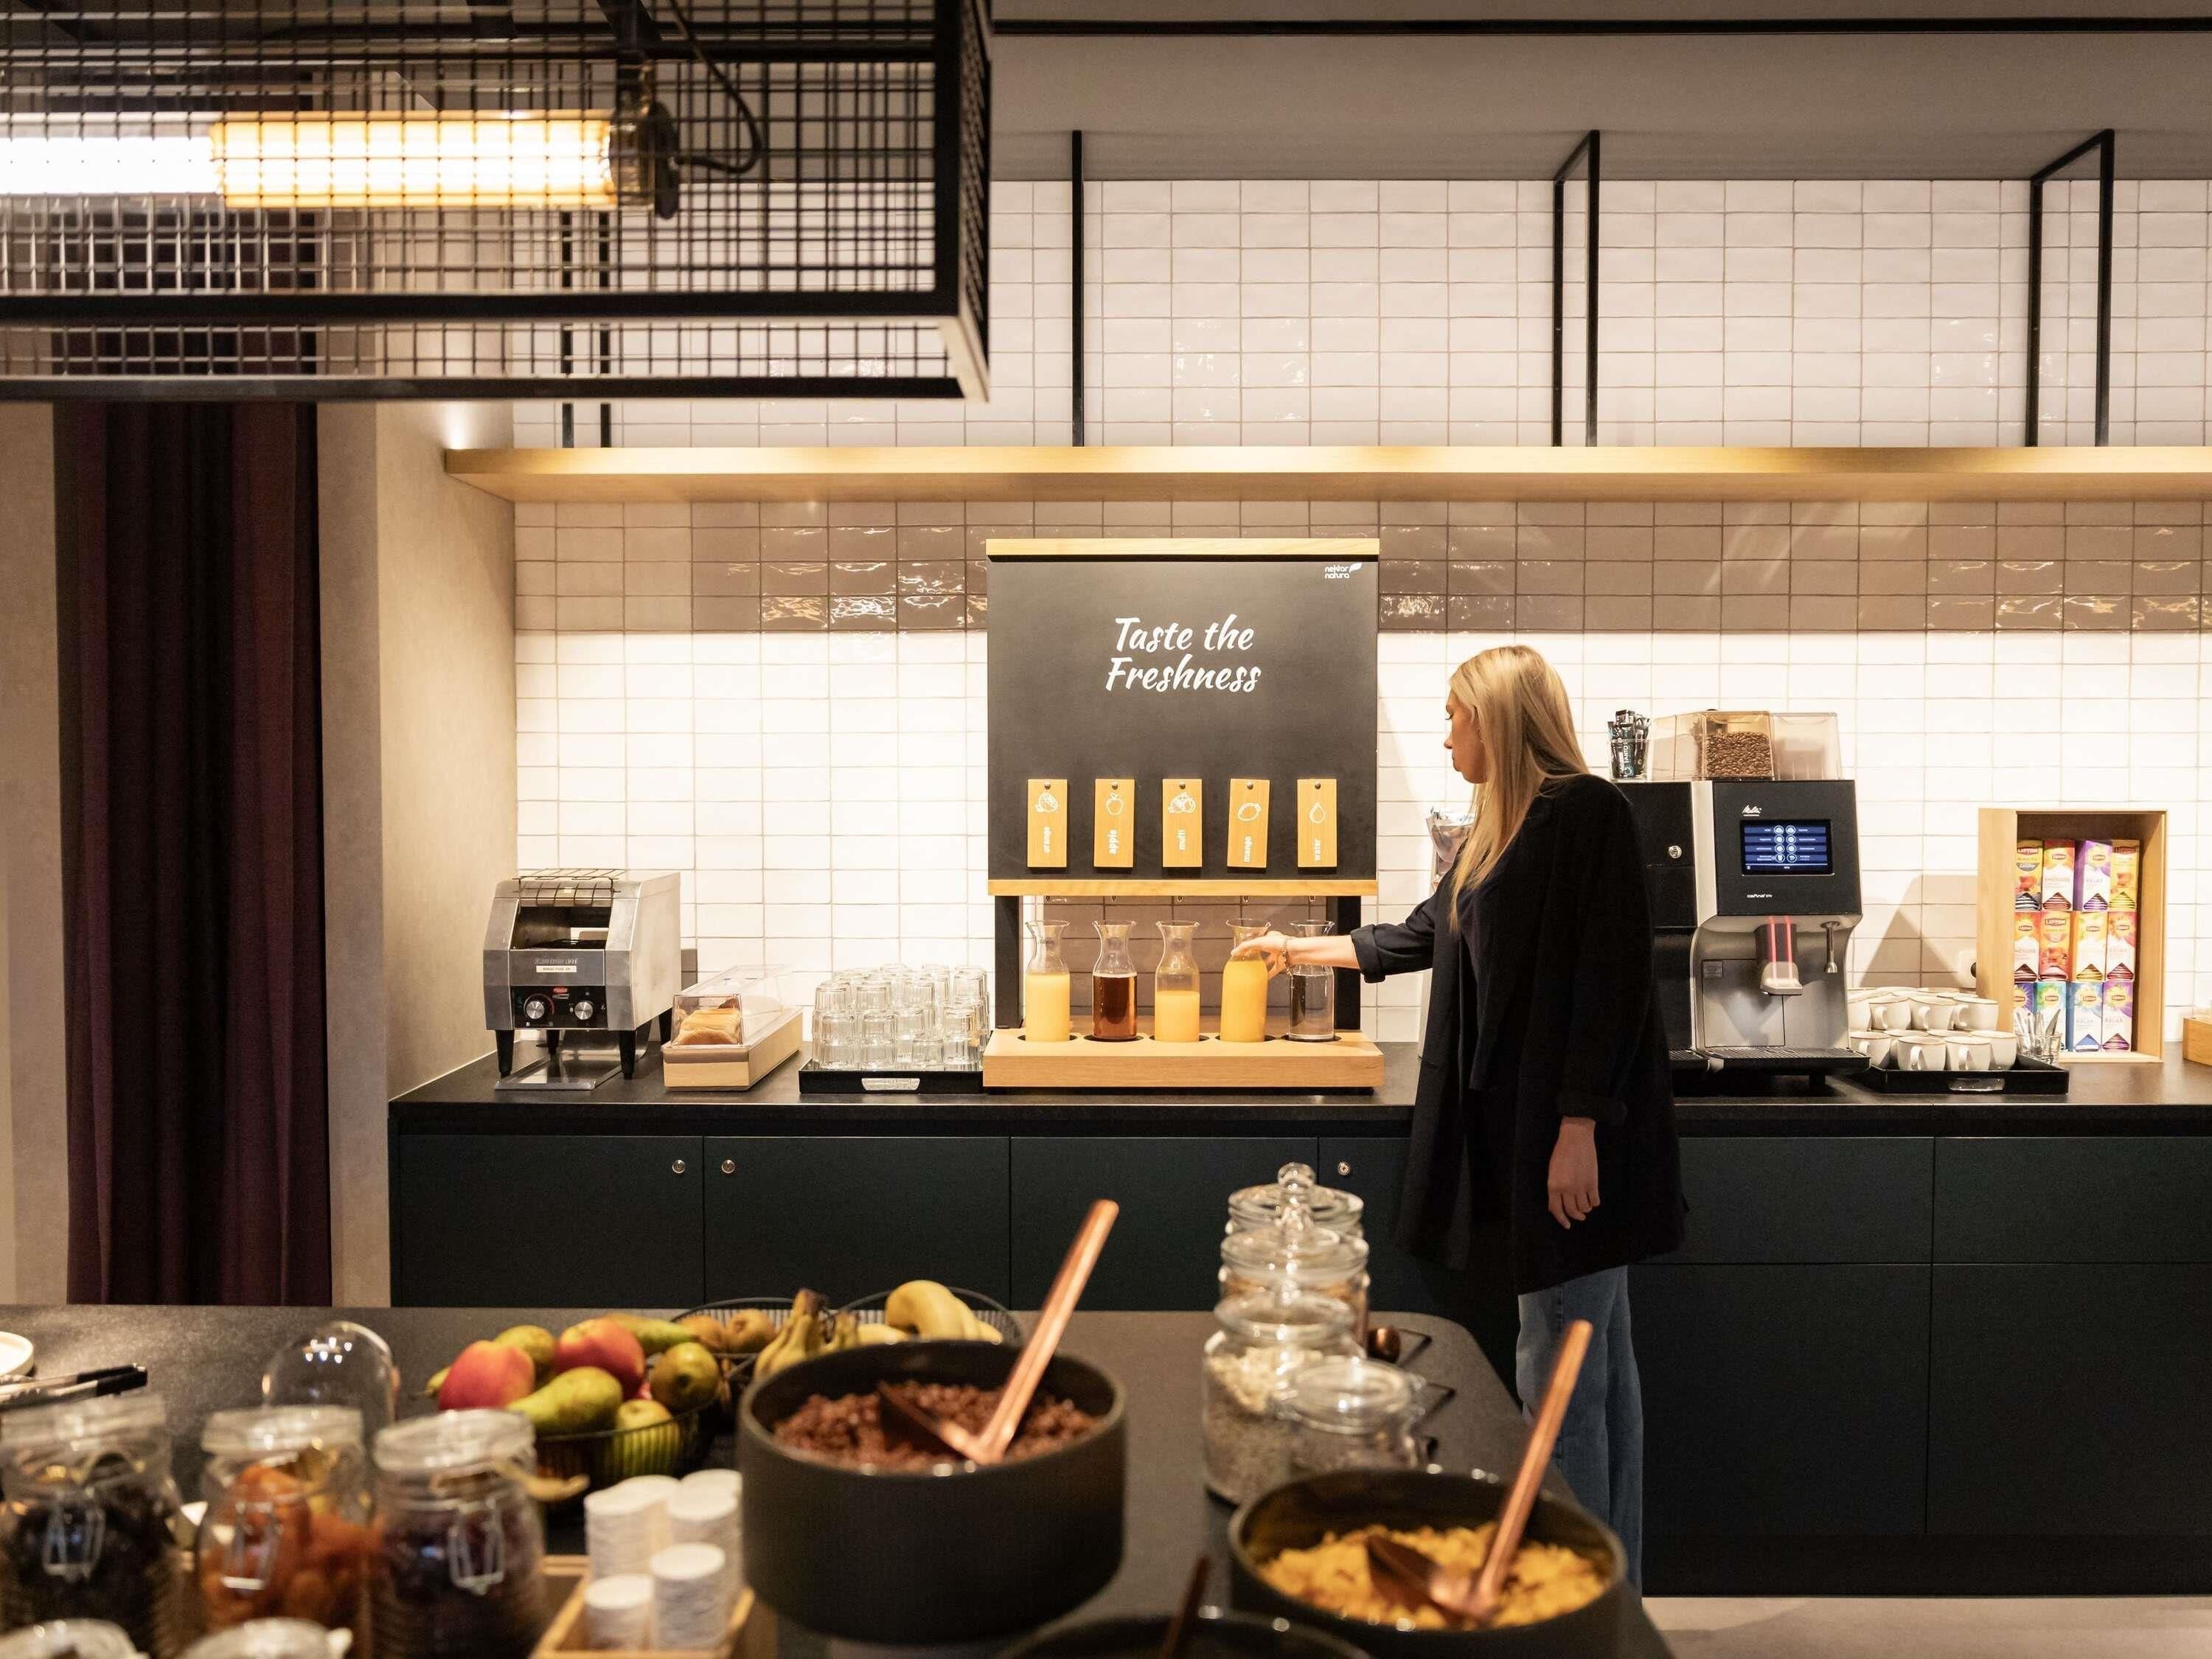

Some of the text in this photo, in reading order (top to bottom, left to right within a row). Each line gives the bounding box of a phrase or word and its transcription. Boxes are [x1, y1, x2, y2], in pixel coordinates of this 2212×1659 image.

[1116, 613, 1254, 653] Taste the
[1105, 653, 1262, 692] Freshness
[1108, 829, 1119, 855] apple
[1176, 829, 1186, 850] multi
[1243, 835, 1253, 863] mango
[1313, 838, 1321, 862] water
